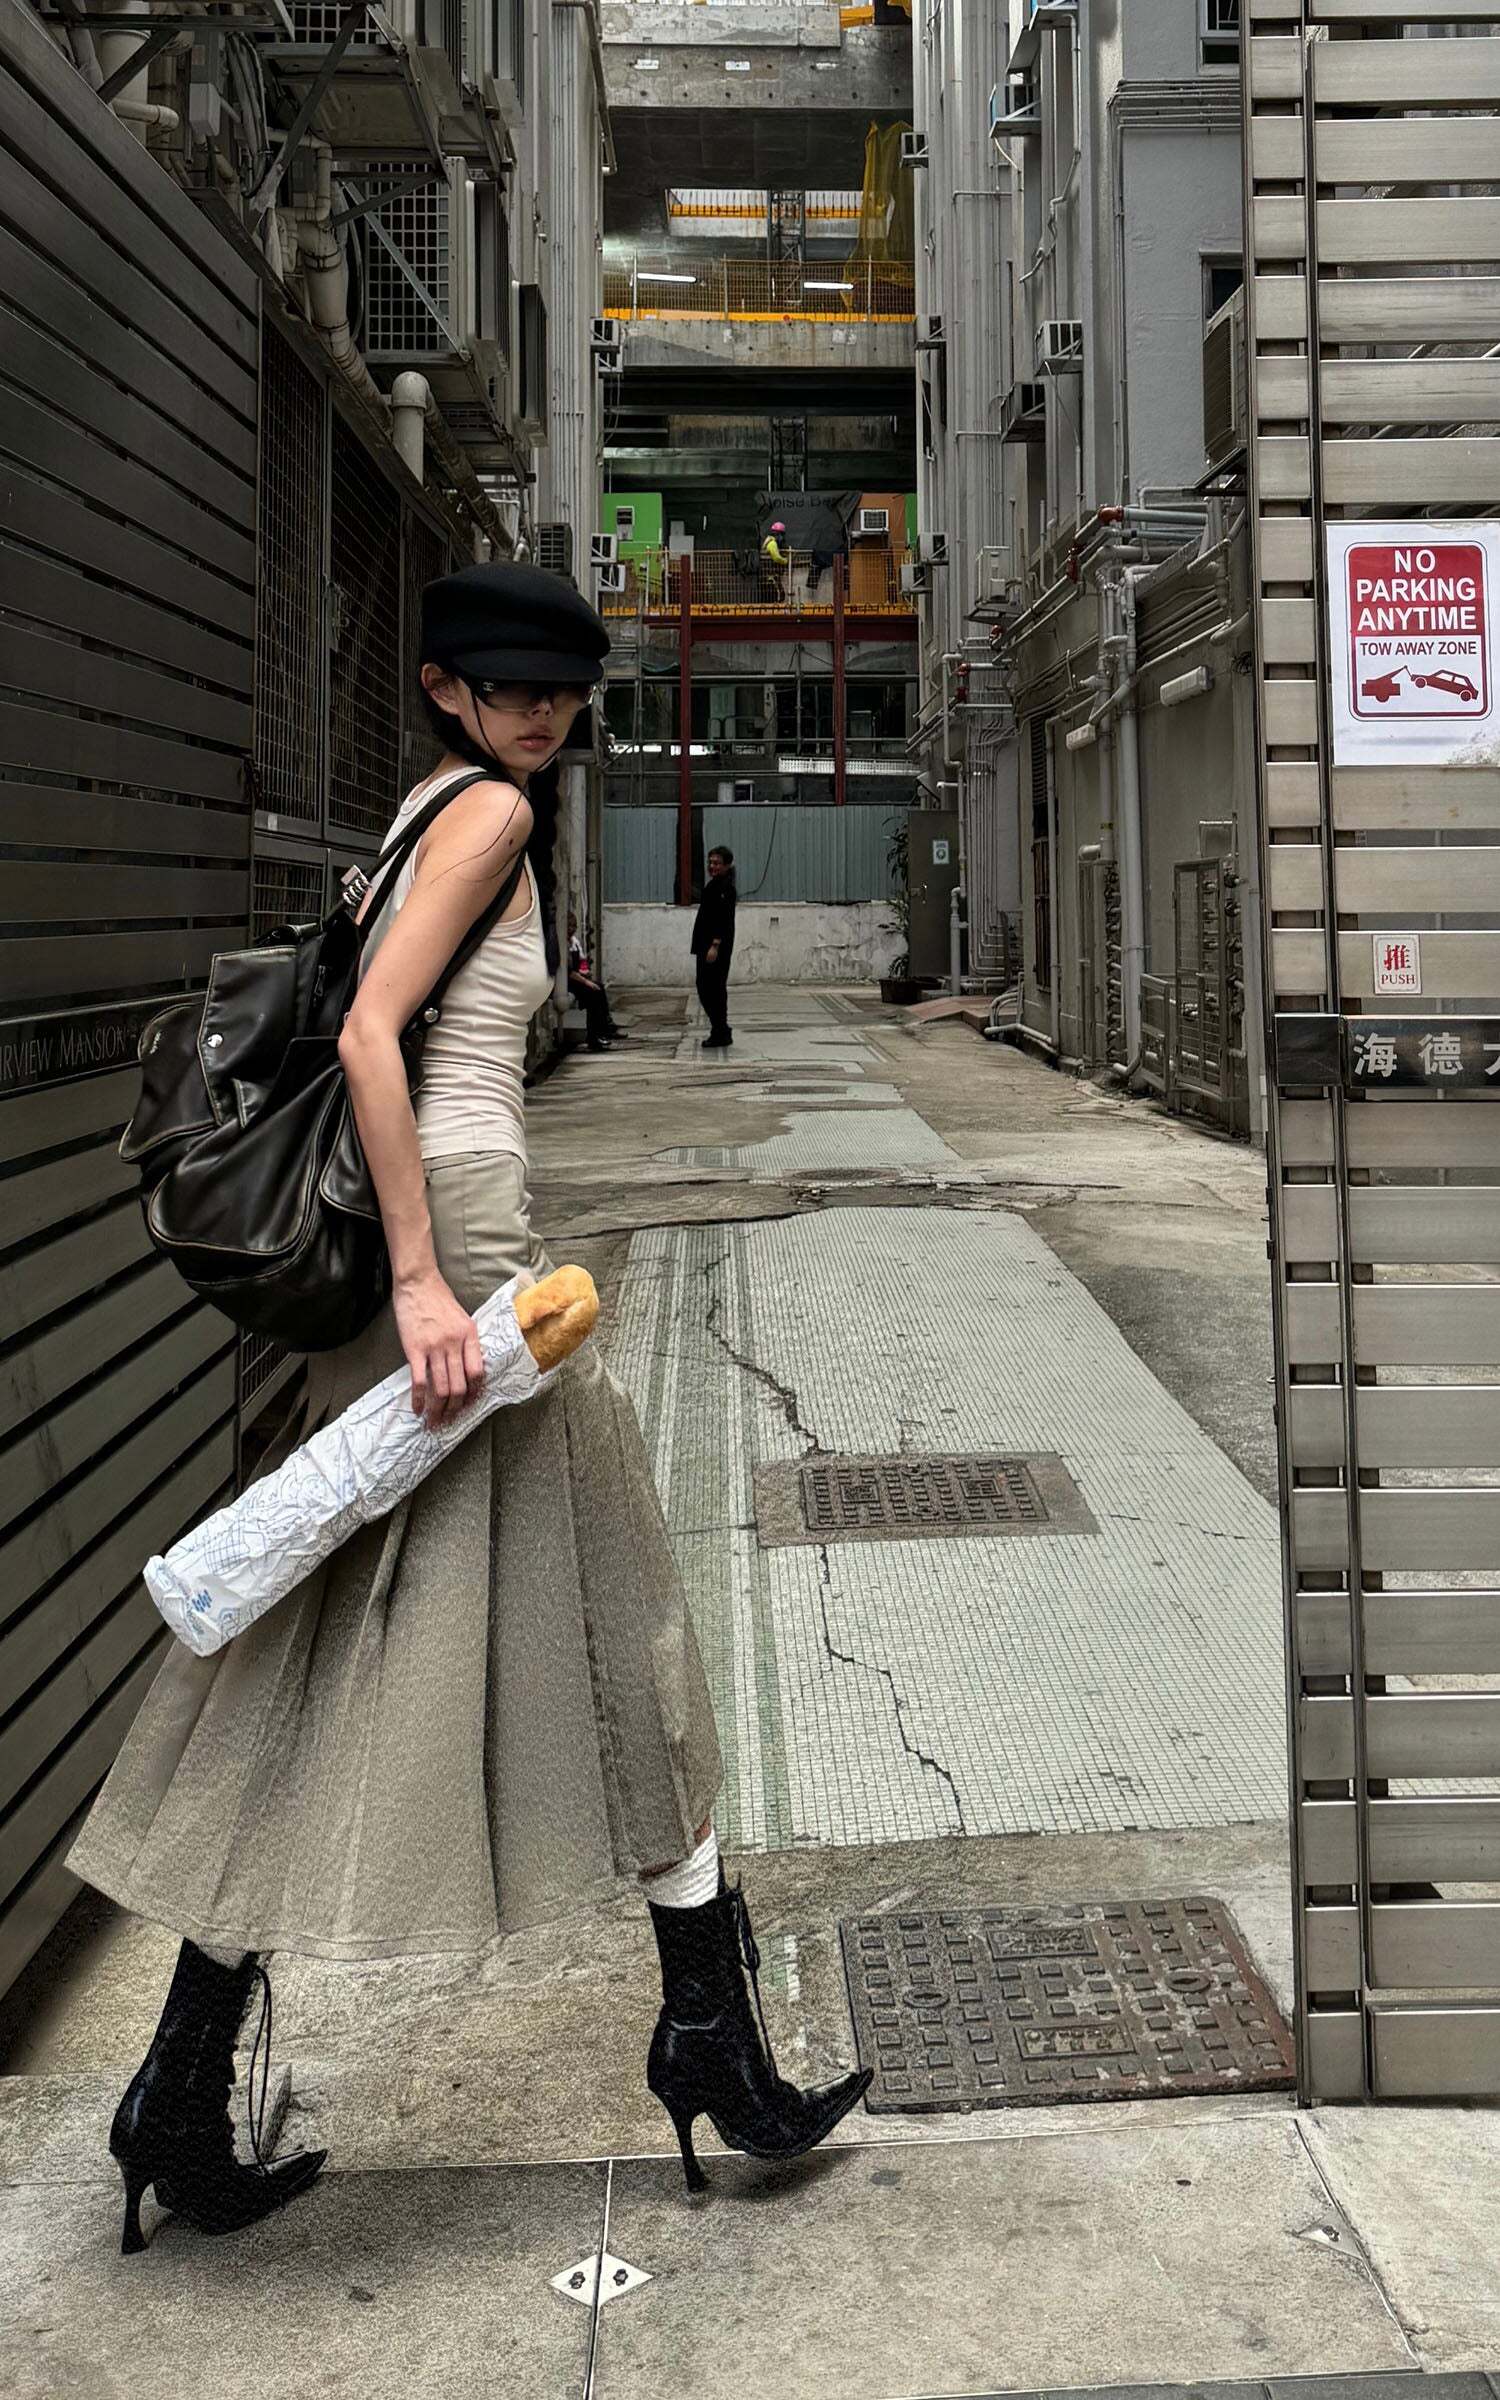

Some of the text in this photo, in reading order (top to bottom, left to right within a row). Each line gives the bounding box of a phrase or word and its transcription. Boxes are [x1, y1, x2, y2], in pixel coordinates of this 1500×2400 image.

[1394, 549, 1436, 573] NO
[1356, 577, 1476, 602] PARKING
[1357, 606, 1477, 631] ANYTIME
[1360, 641, 1477, 656] TOW AWAY ZONE
[1383, 944, 1411, 971] 推
[1381, 974, 1415, 985] PUSH
[60, 1025, 127, 1066] MANSION
